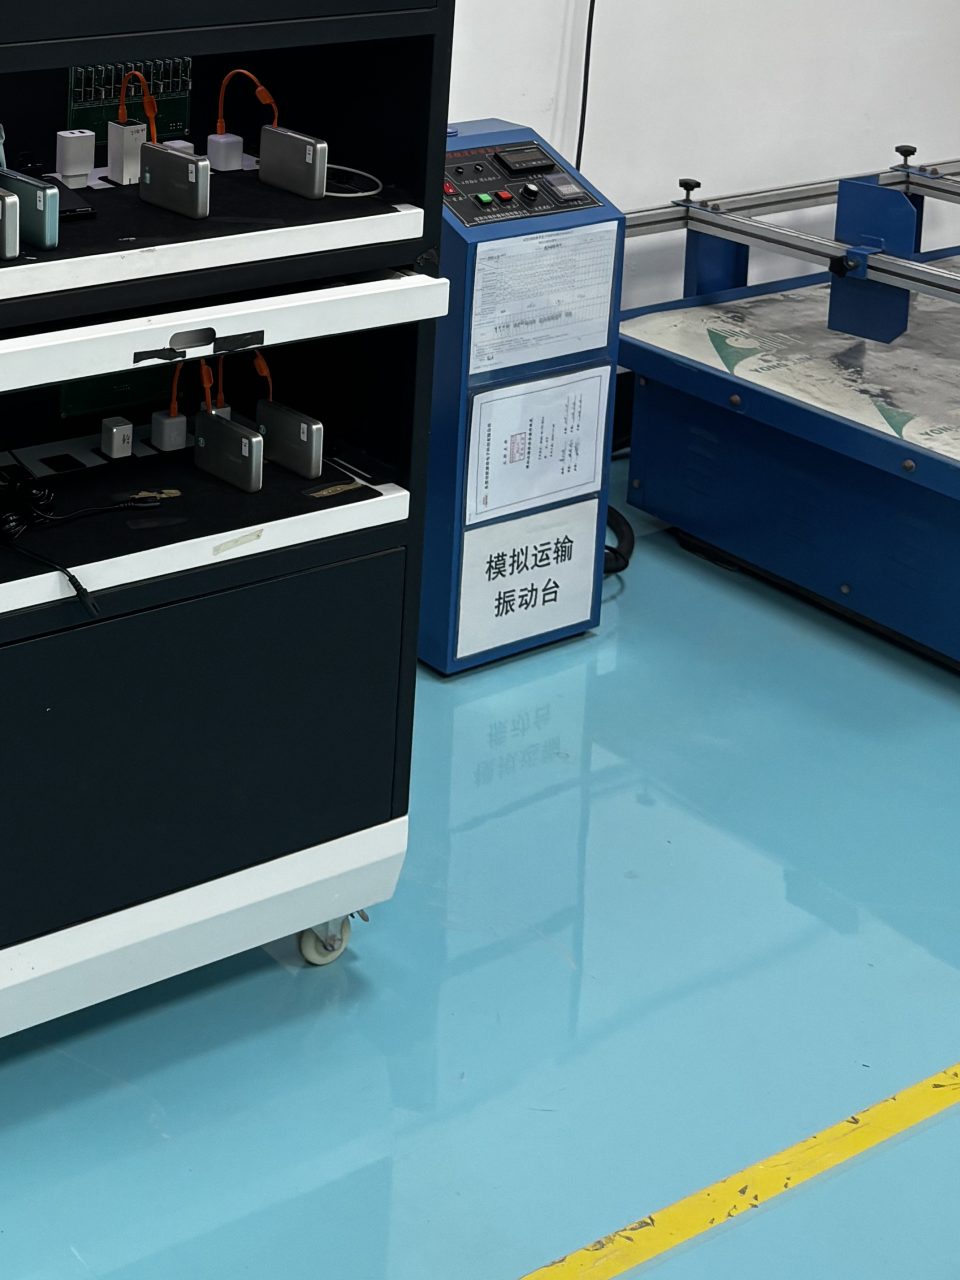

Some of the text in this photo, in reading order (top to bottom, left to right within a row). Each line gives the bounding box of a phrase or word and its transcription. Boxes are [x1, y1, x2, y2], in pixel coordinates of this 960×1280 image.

[485, 534, 574, 583] 模拟运输
[494, 578, 561, 618] 振动台
